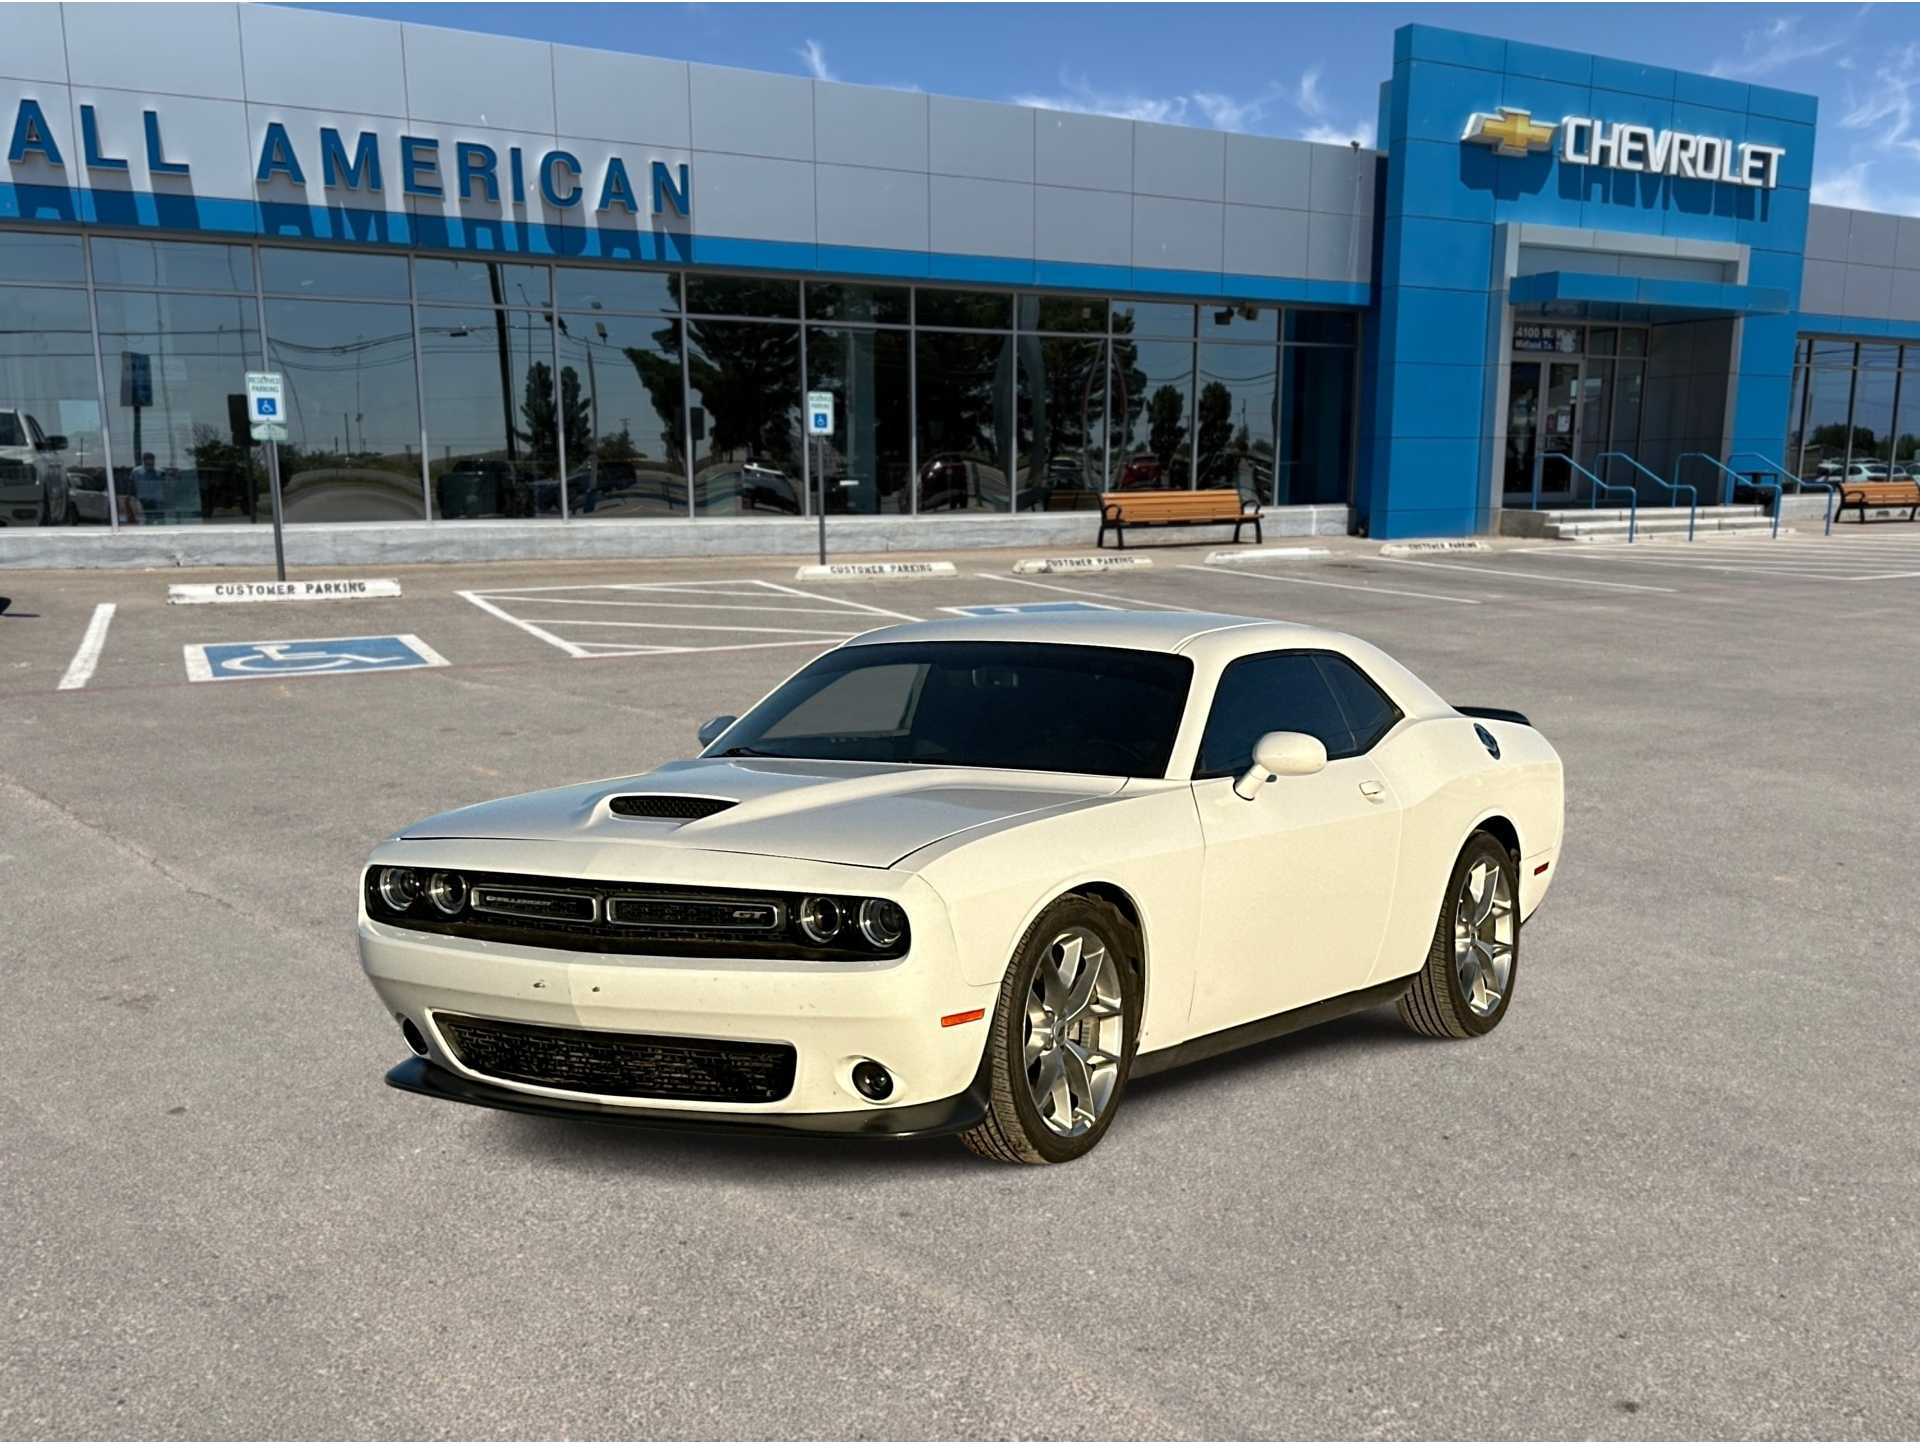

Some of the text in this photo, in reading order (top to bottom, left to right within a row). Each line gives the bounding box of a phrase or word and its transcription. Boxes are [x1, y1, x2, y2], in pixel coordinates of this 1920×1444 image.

[8, 99, 690, 216] ALL AMERICAN
[1561, 115, 1786, 188] CHEVROLET
[1046, 556, 1135, 567] CUSTOMER PARKING
[830, 563, 933, 575] CUSTOMER PARKING
[215, 582, 367, 596] CUSTOMER PARKING
[732, 910, 767, 920] GT
